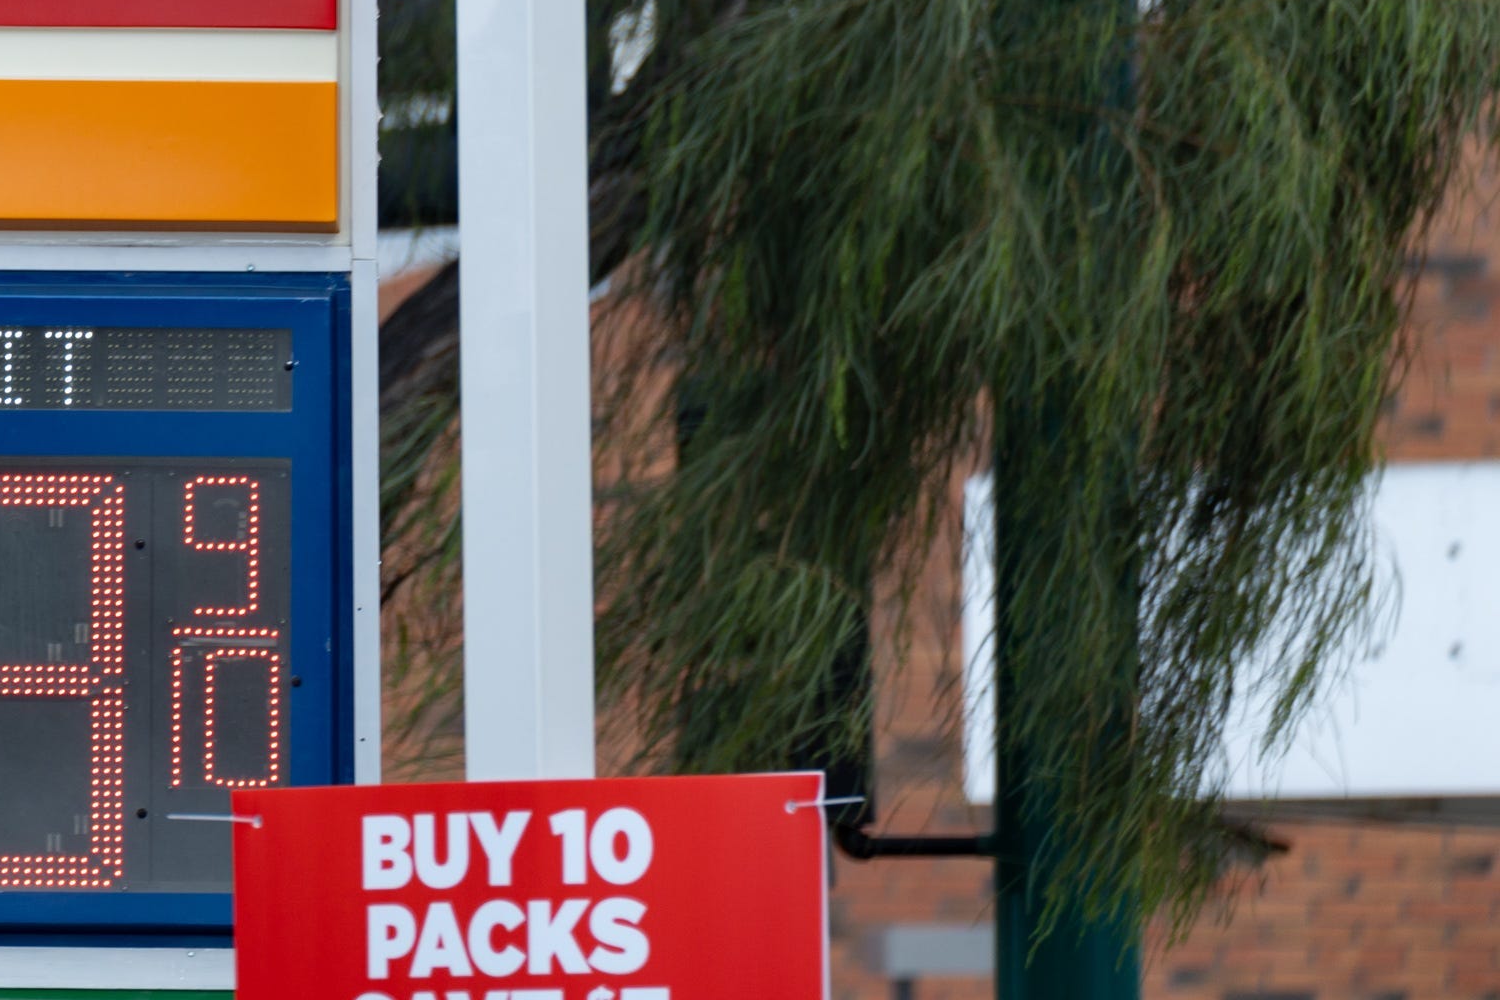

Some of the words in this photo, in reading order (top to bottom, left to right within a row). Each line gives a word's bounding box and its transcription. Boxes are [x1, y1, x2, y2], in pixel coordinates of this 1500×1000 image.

[361, 810, 533, 891] BUY
[548, 806, 655, 886] 10
[366, 896, 651, 980] PACKS
